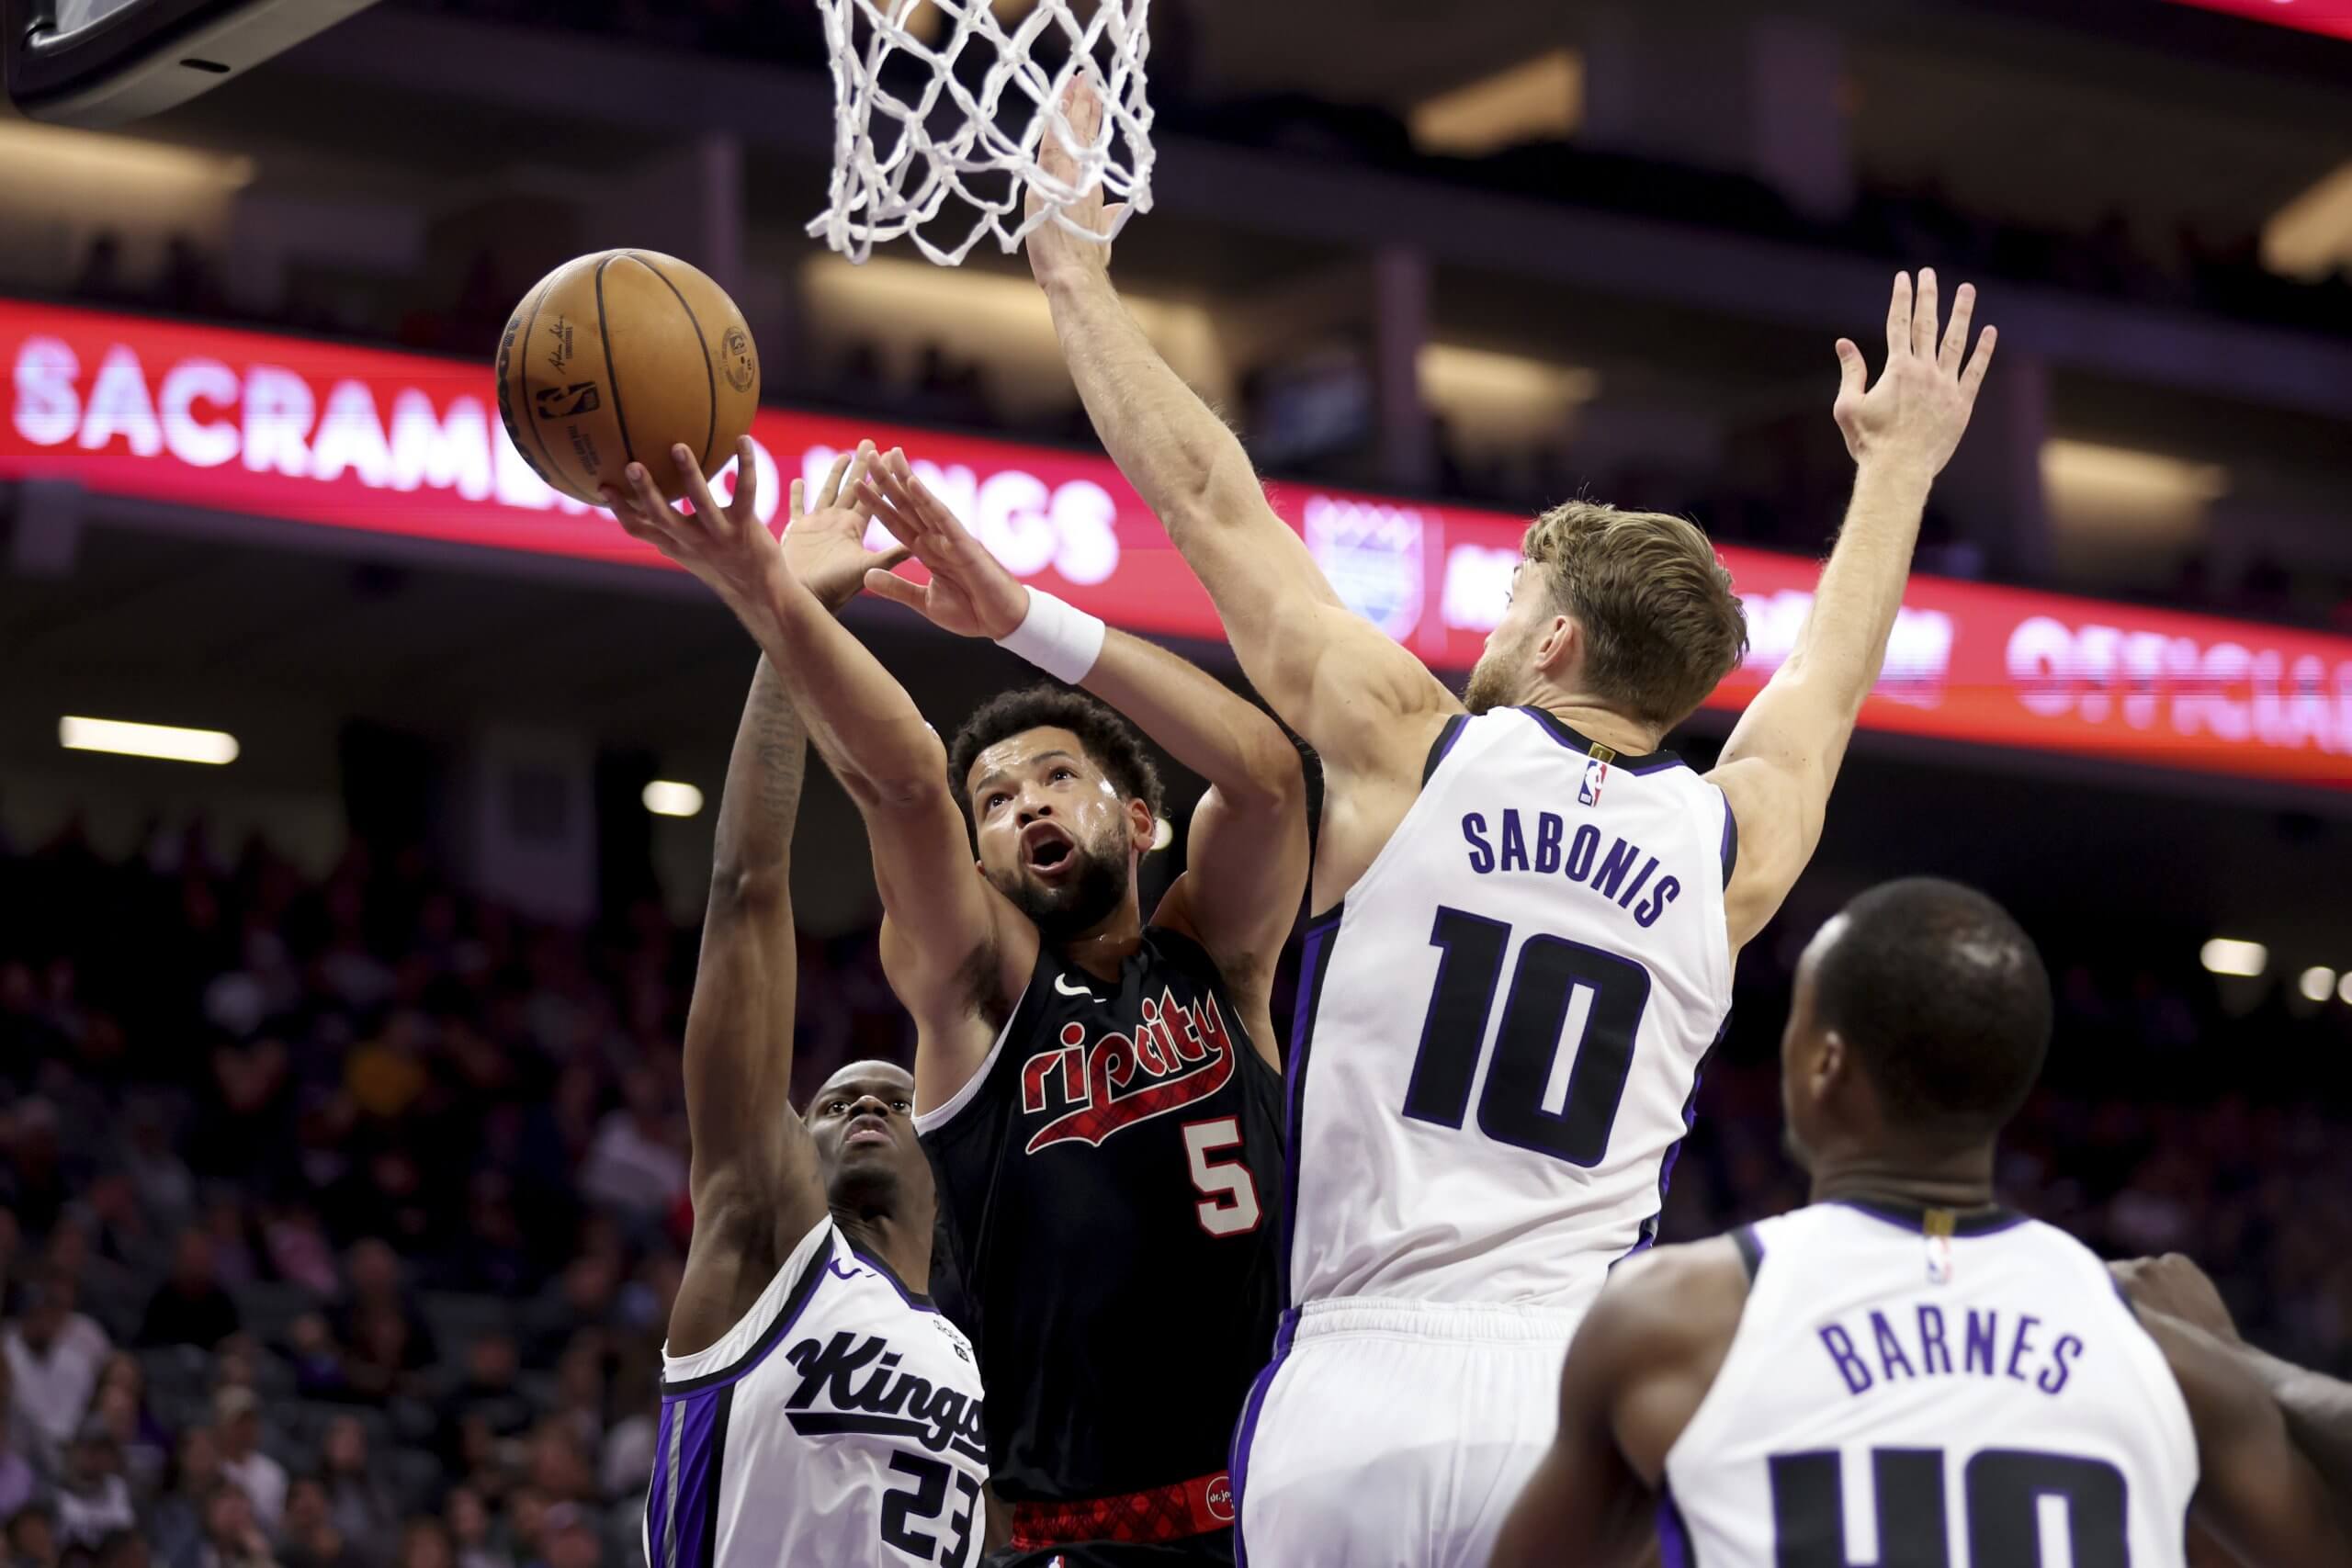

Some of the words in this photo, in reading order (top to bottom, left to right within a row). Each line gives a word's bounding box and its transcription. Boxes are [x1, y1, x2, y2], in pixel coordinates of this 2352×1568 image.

[1461, 808, 1681, 929] SABONIS
[1402, 905, 1651, 1168] 10
[1182, 1114, 1262, 1238] 5
[785, 1331, 986, 1453] Kings
[1818, 1305, 2084, 1395] BARNES
[880, 1450, 981, 1568] 23
[1767, 1447, 2131, 1568] 40
